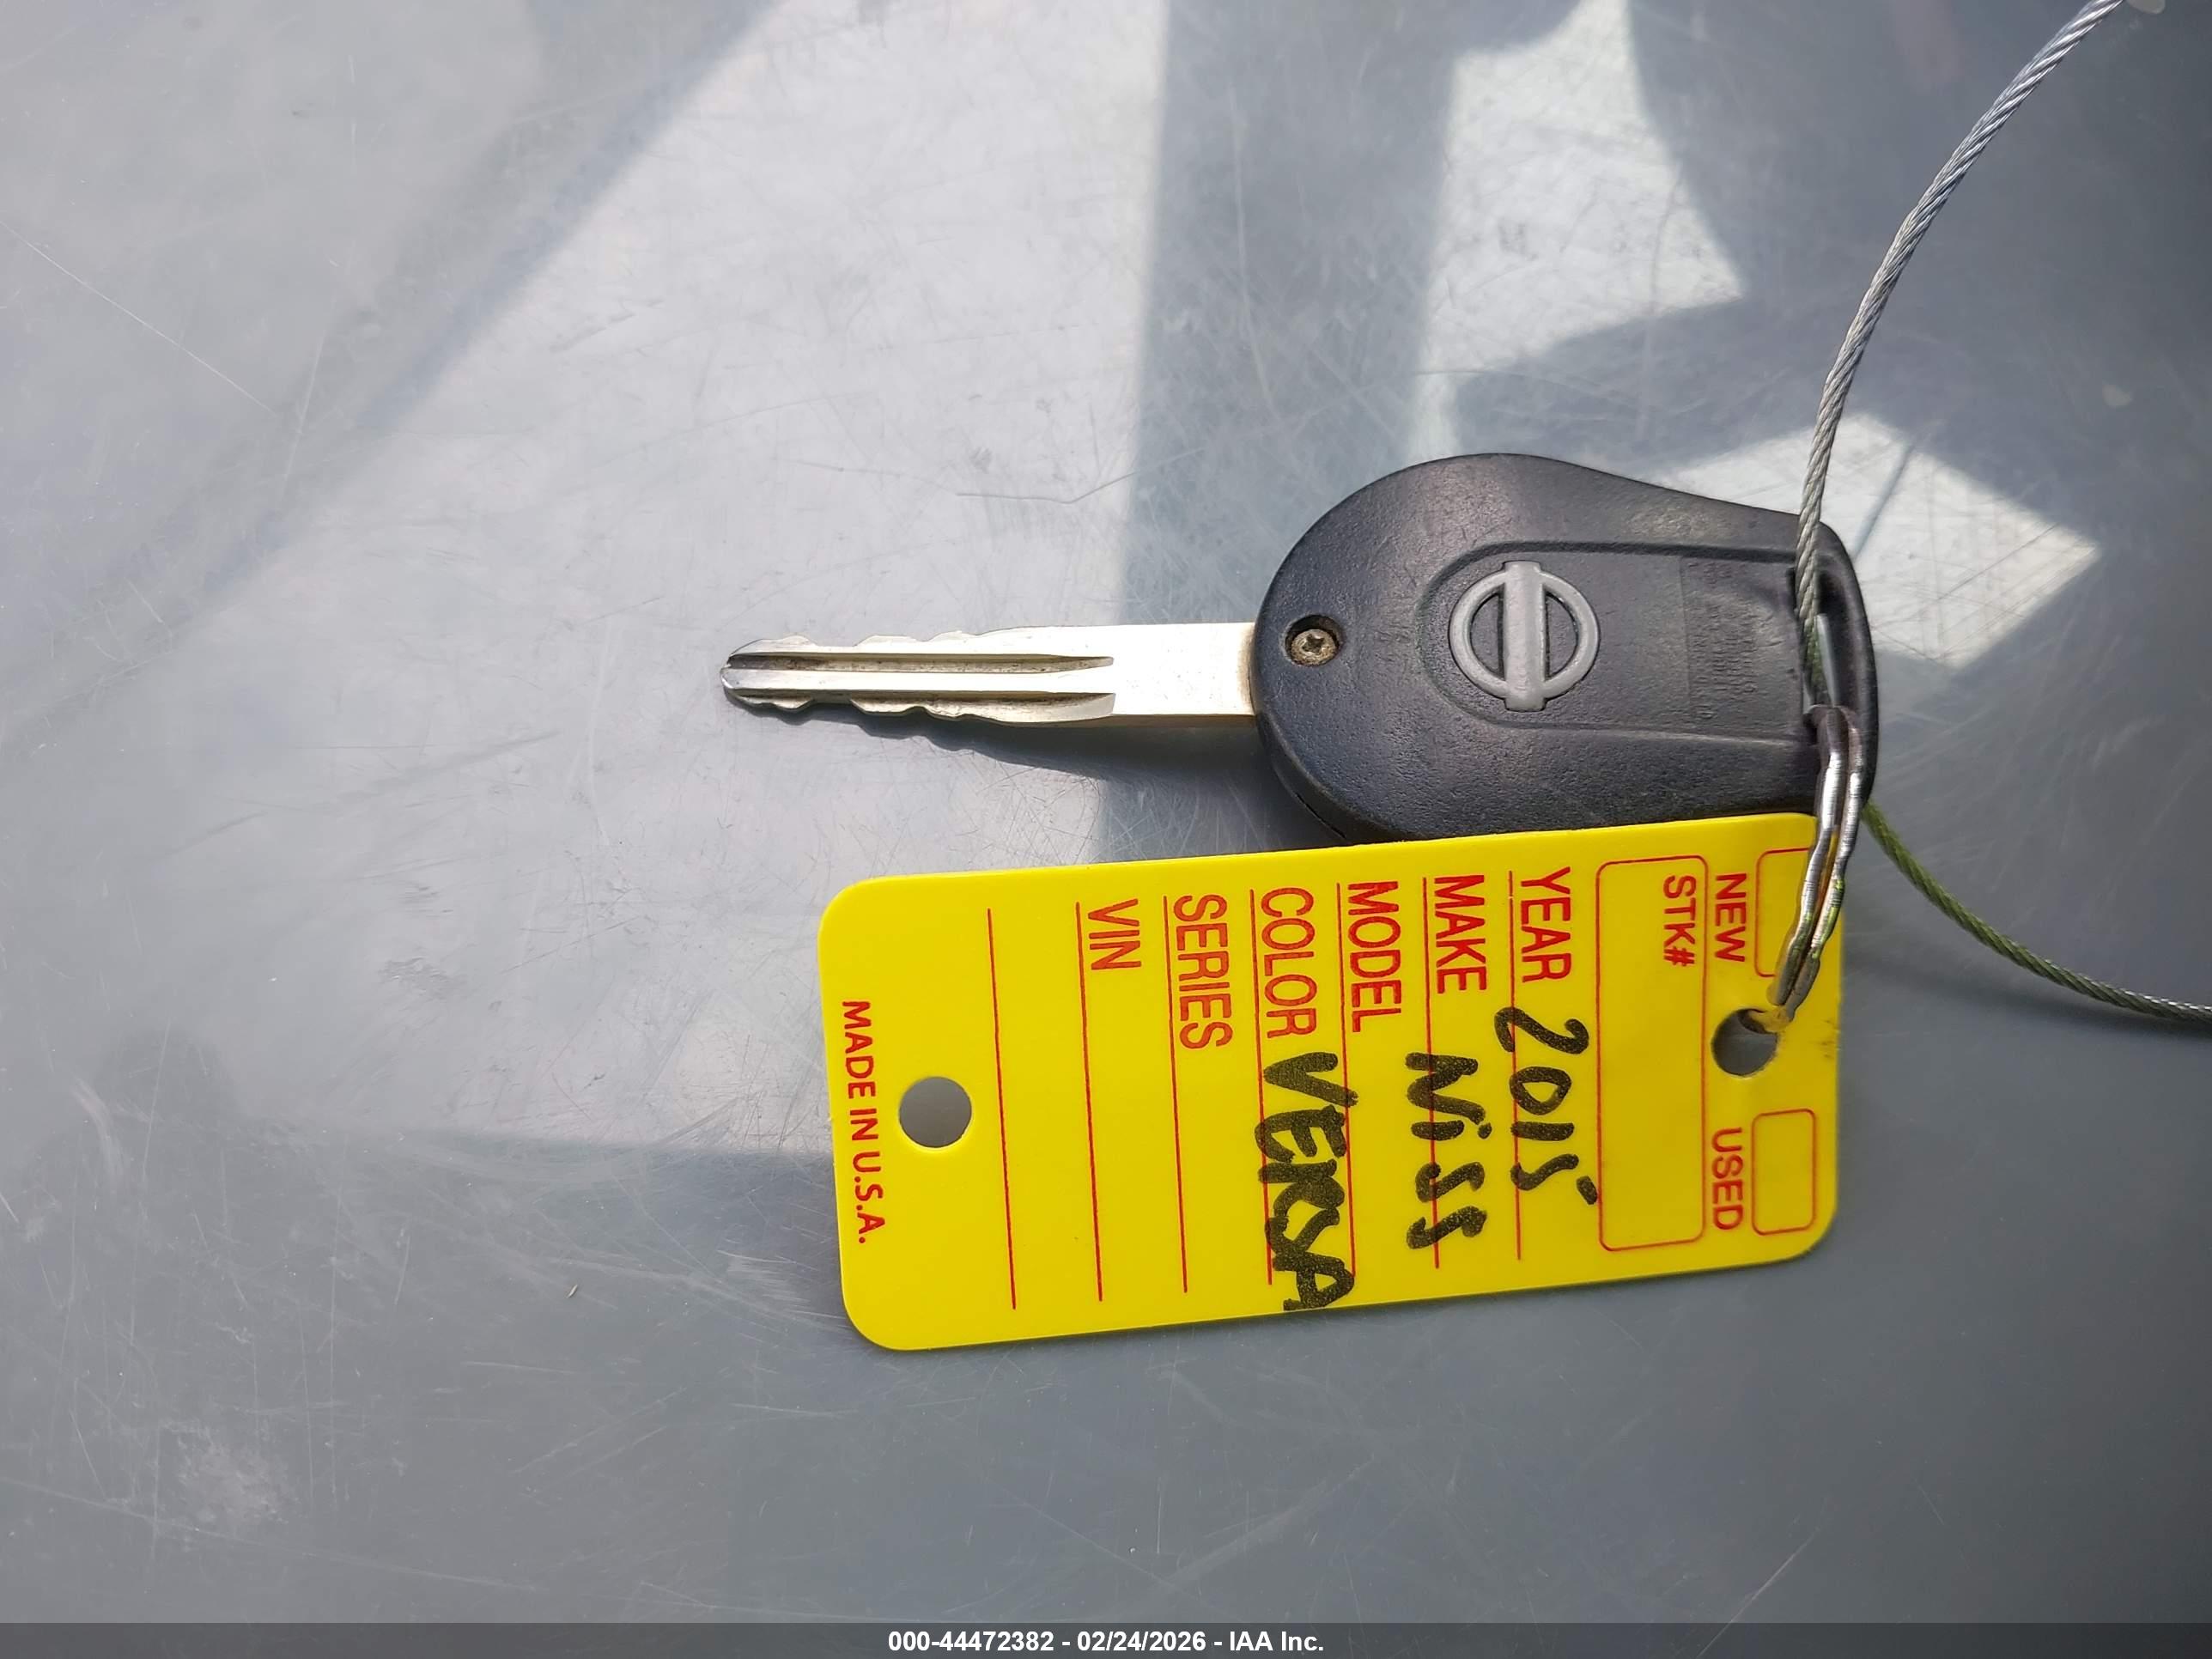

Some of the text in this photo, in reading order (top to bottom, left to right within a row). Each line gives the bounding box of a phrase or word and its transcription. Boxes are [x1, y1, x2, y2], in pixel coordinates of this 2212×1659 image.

[1087, 897, 1141, 972] VIN
[1173, 893, 1234, 1050] SERIES
[1259, 886, 1319, 1039] COLOR
[1346, 879, 1403, 1035] MODEL
[1432, 872, 1489, 995] MAKE
[1518, 866, 1574, 984] YEAR
[1662, 873, 1699, 967] STK#
[1712, 871, 1750, 963] NEW
[841, 999, 887, 1245] MADE IN U.S.A.
[1495, 1007, 1597, 1205] 2015
[1256, 1052, 1357, 1311] VERSA
[1710, 1126, 1746, 1232] USED
